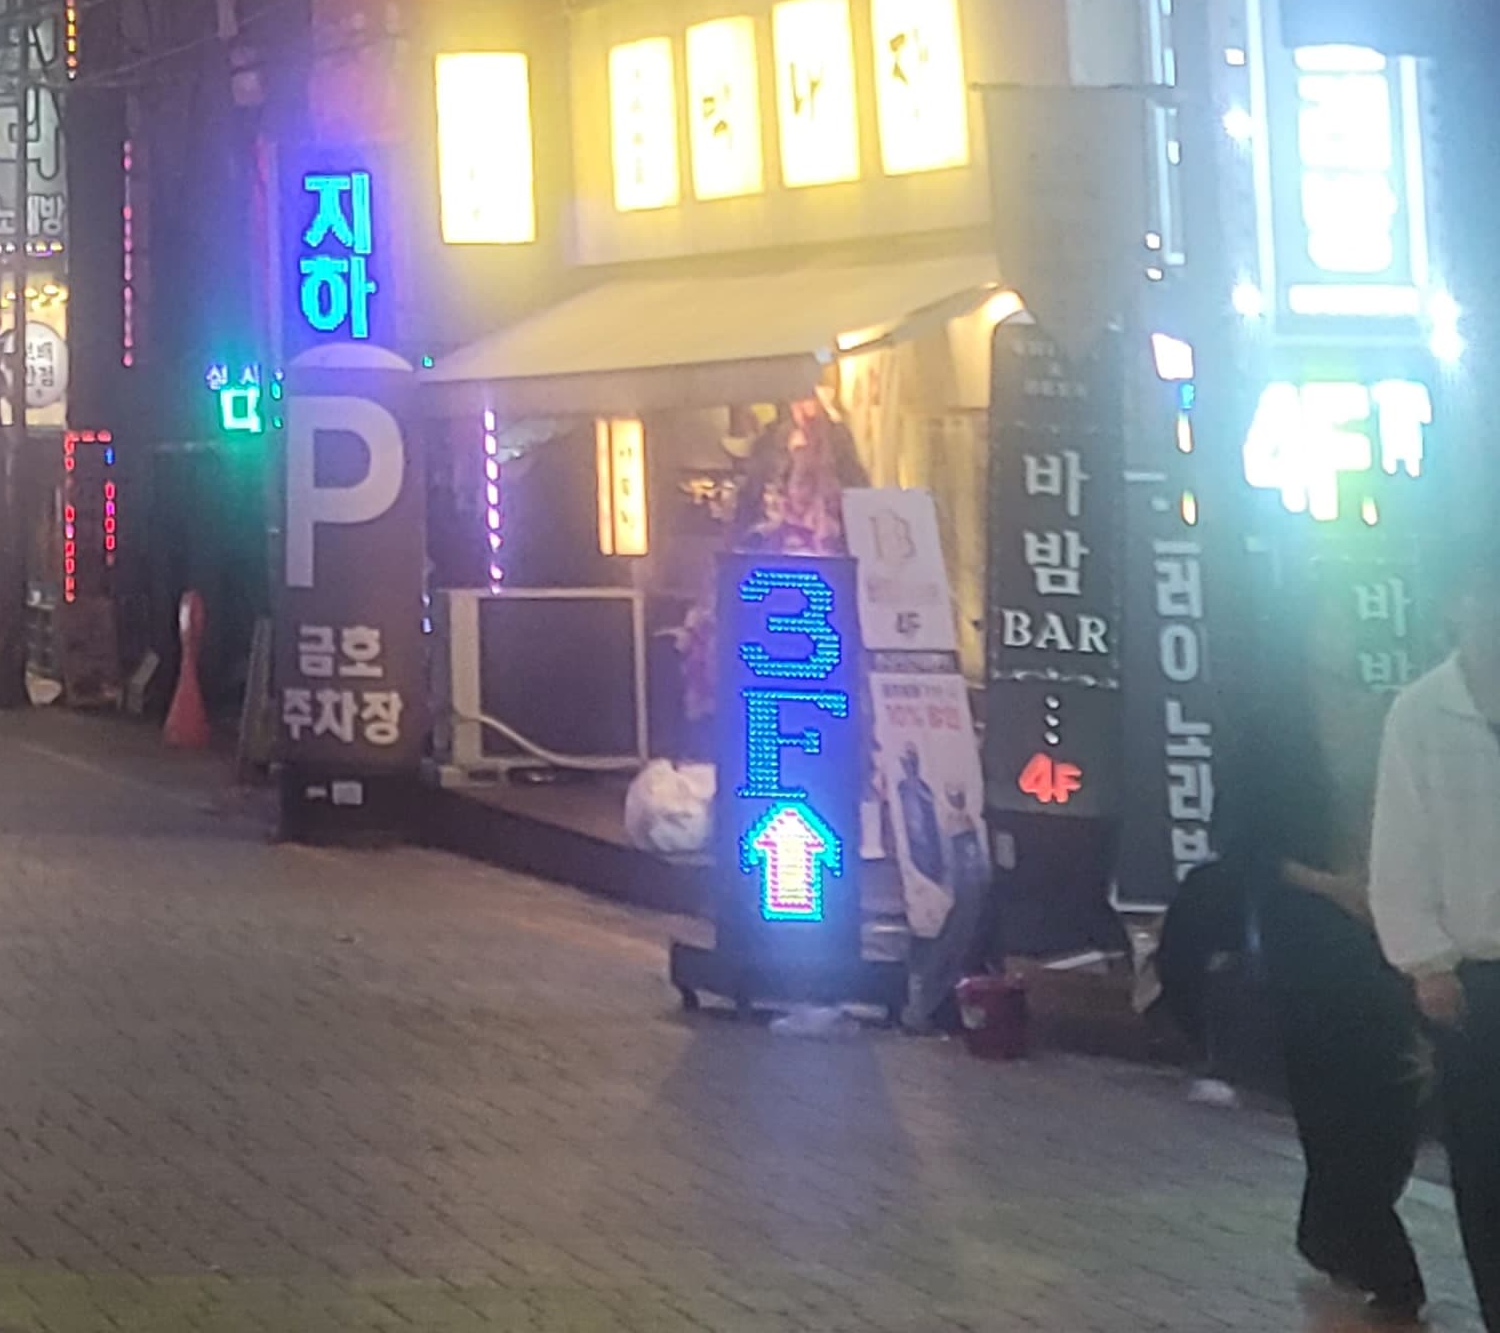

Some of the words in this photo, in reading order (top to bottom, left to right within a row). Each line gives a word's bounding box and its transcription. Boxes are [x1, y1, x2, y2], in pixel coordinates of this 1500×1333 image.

[300, 171, 376, 339] 지하
[287, 395, 405, 588] P
[299, 626, 382, 679] 금호
[1002, 610, 1114, 657] BAR
[737, 569, 849, 800] 3F
[283, 688, 403, 745] 주차장
[1017, 751, 1084, 806] 4F
